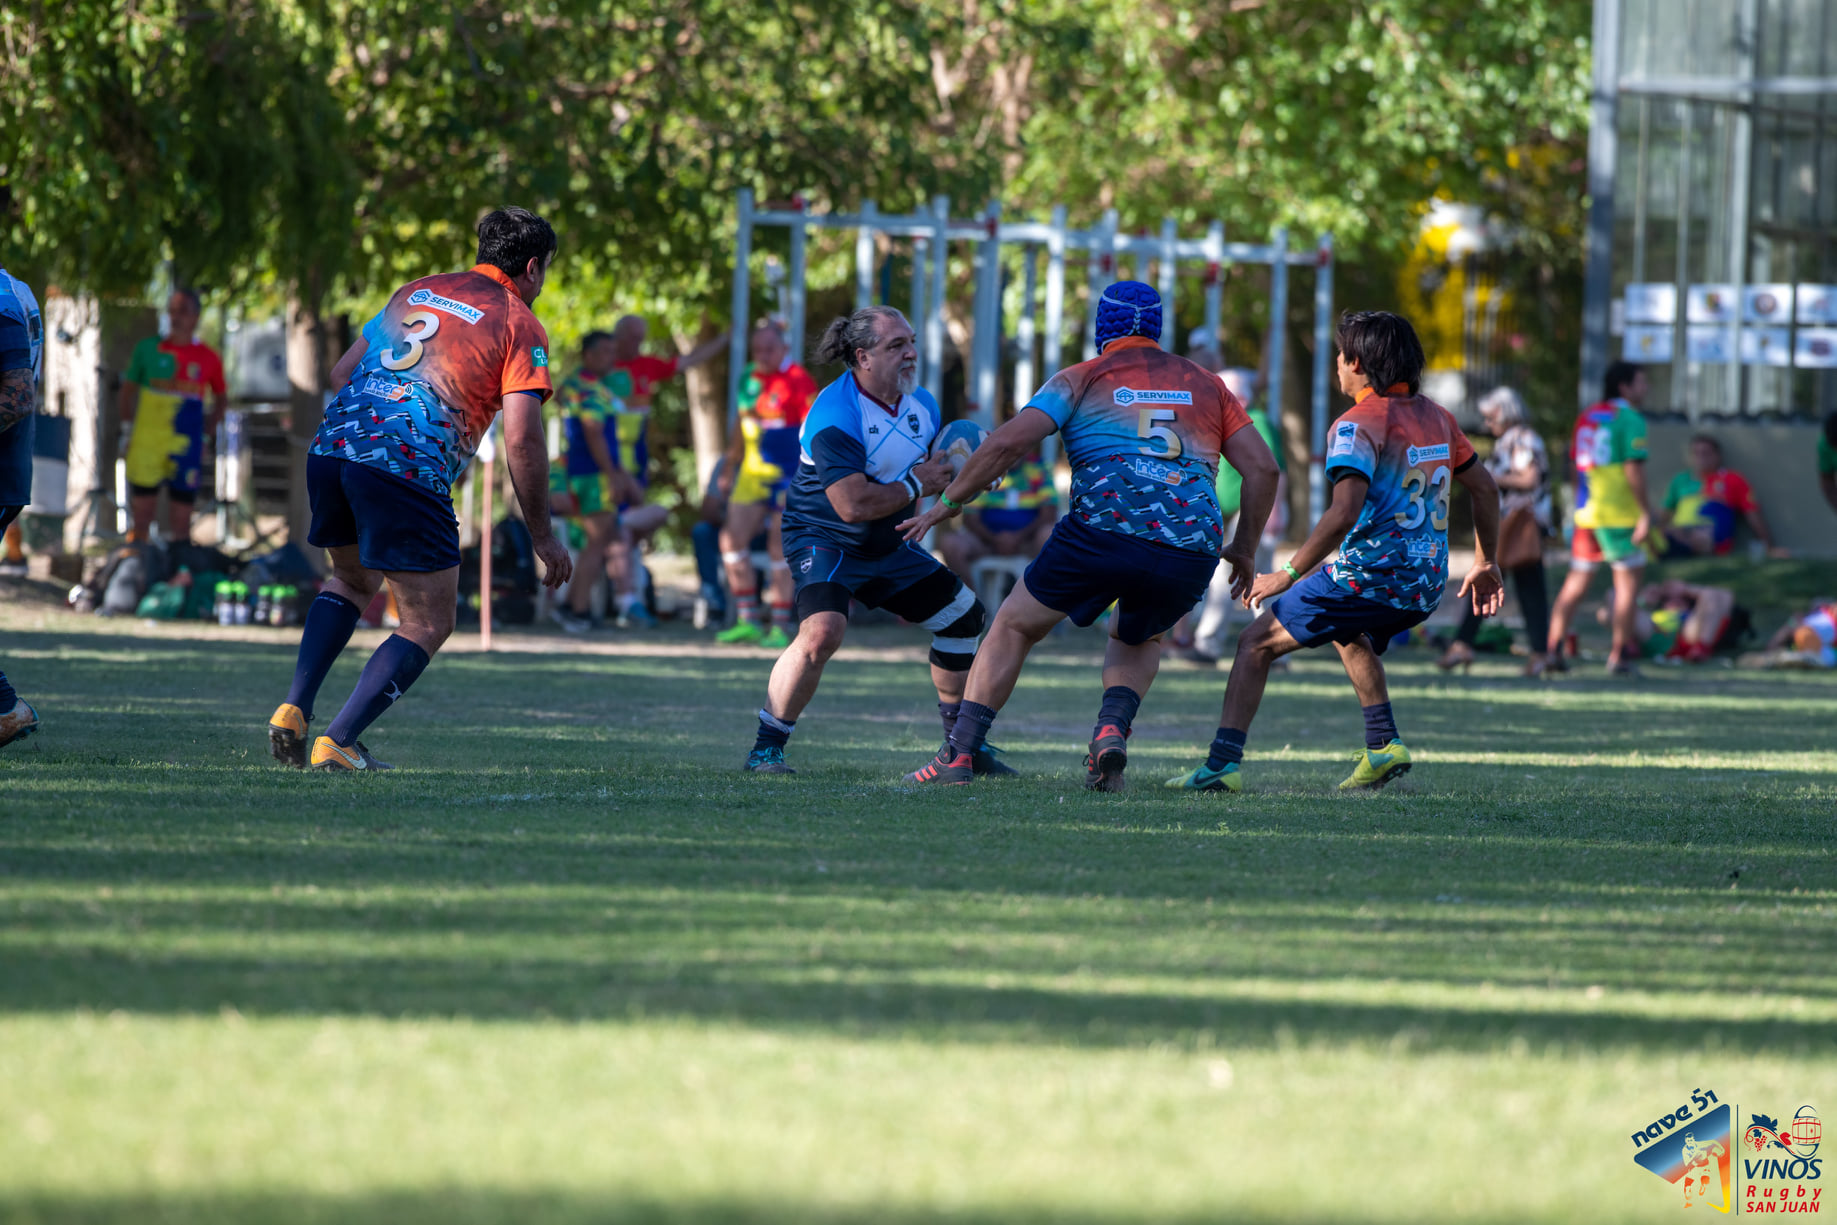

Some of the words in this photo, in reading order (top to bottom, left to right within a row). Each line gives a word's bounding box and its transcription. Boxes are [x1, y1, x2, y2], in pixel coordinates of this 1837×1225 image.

[429, 296, 481, 319] SERVIMAX
[381, 311, 440, 371] 3
[1136, 391, 1190, 400] SERVIMAX
[1138, 409, 1182, 460] 5
[1394, 465, 1451, 531] 33
